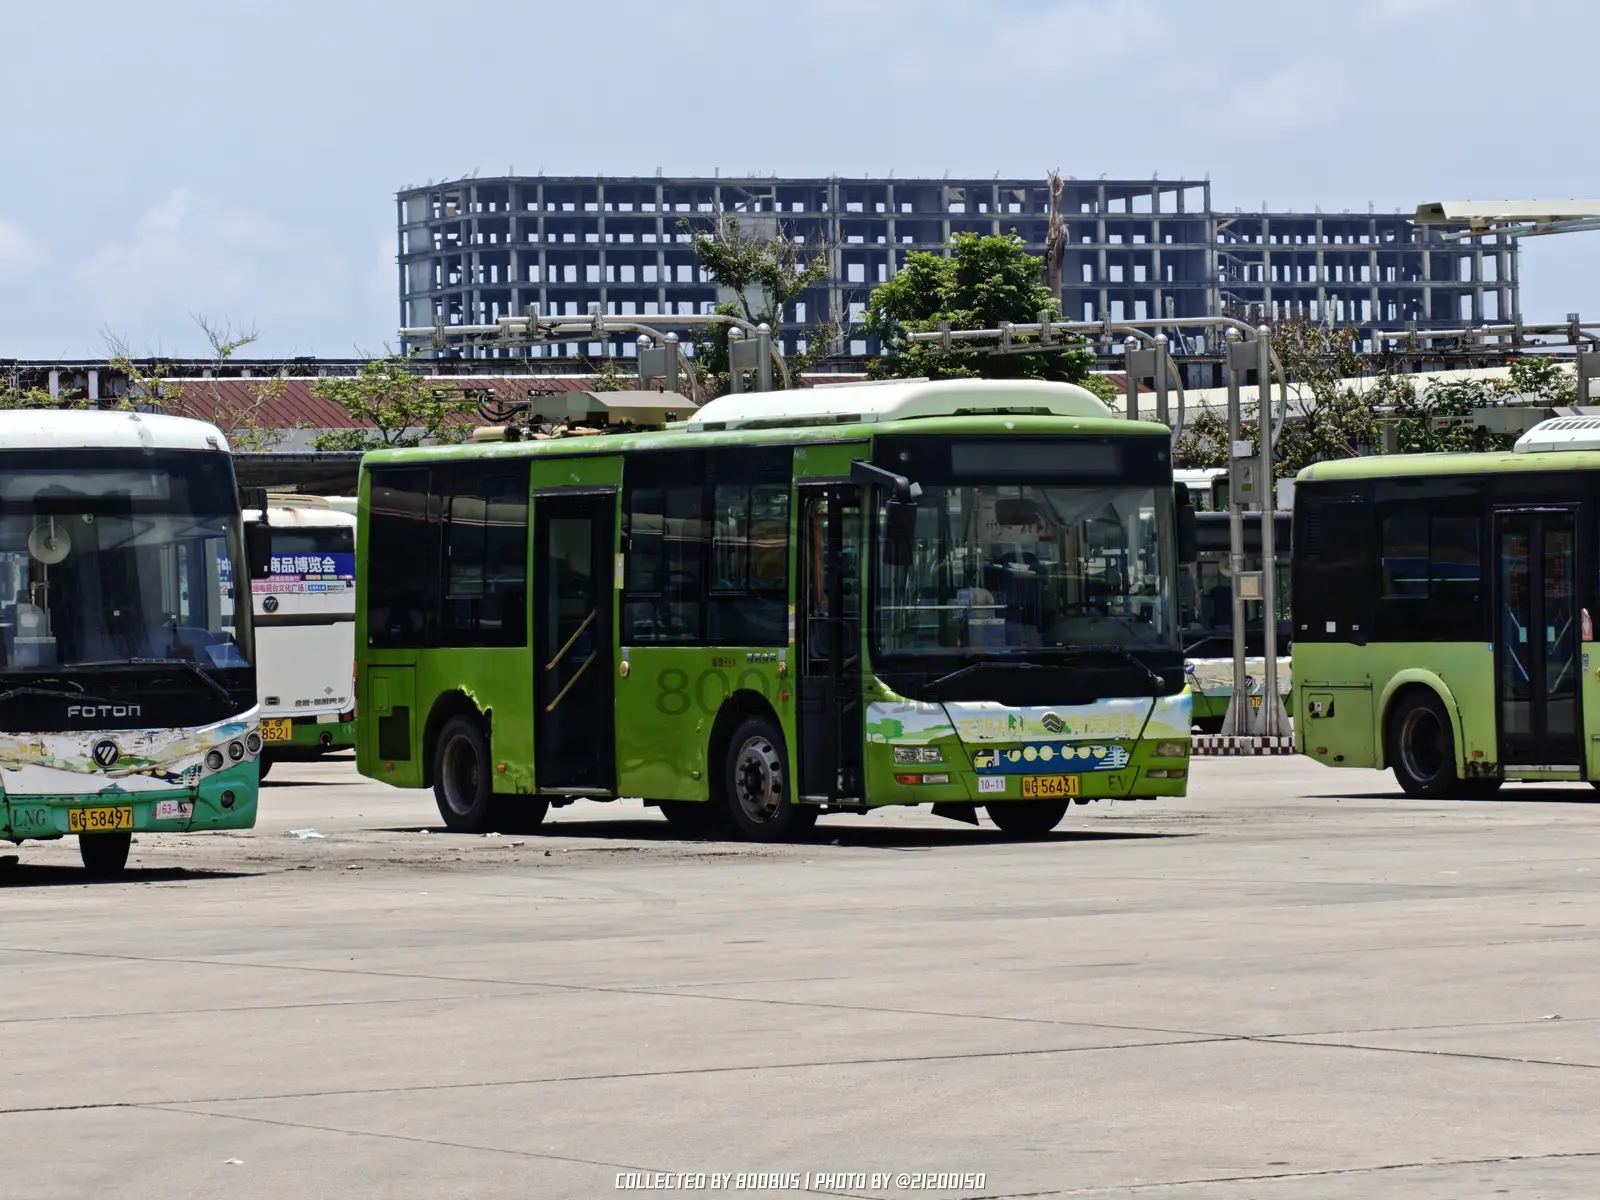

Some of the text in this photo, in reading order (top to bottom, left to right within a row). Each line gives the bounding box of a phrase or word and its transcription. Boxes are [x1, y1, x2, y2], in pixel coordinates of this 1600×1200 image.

[67, 705, 141, 718] FOTON
[259, 728, 288, 740] 8521
[980, 779, 1004, 790] 10-11
[1108, 775, 1128, 791] EV
[13, 808, 46, 828] LNG
